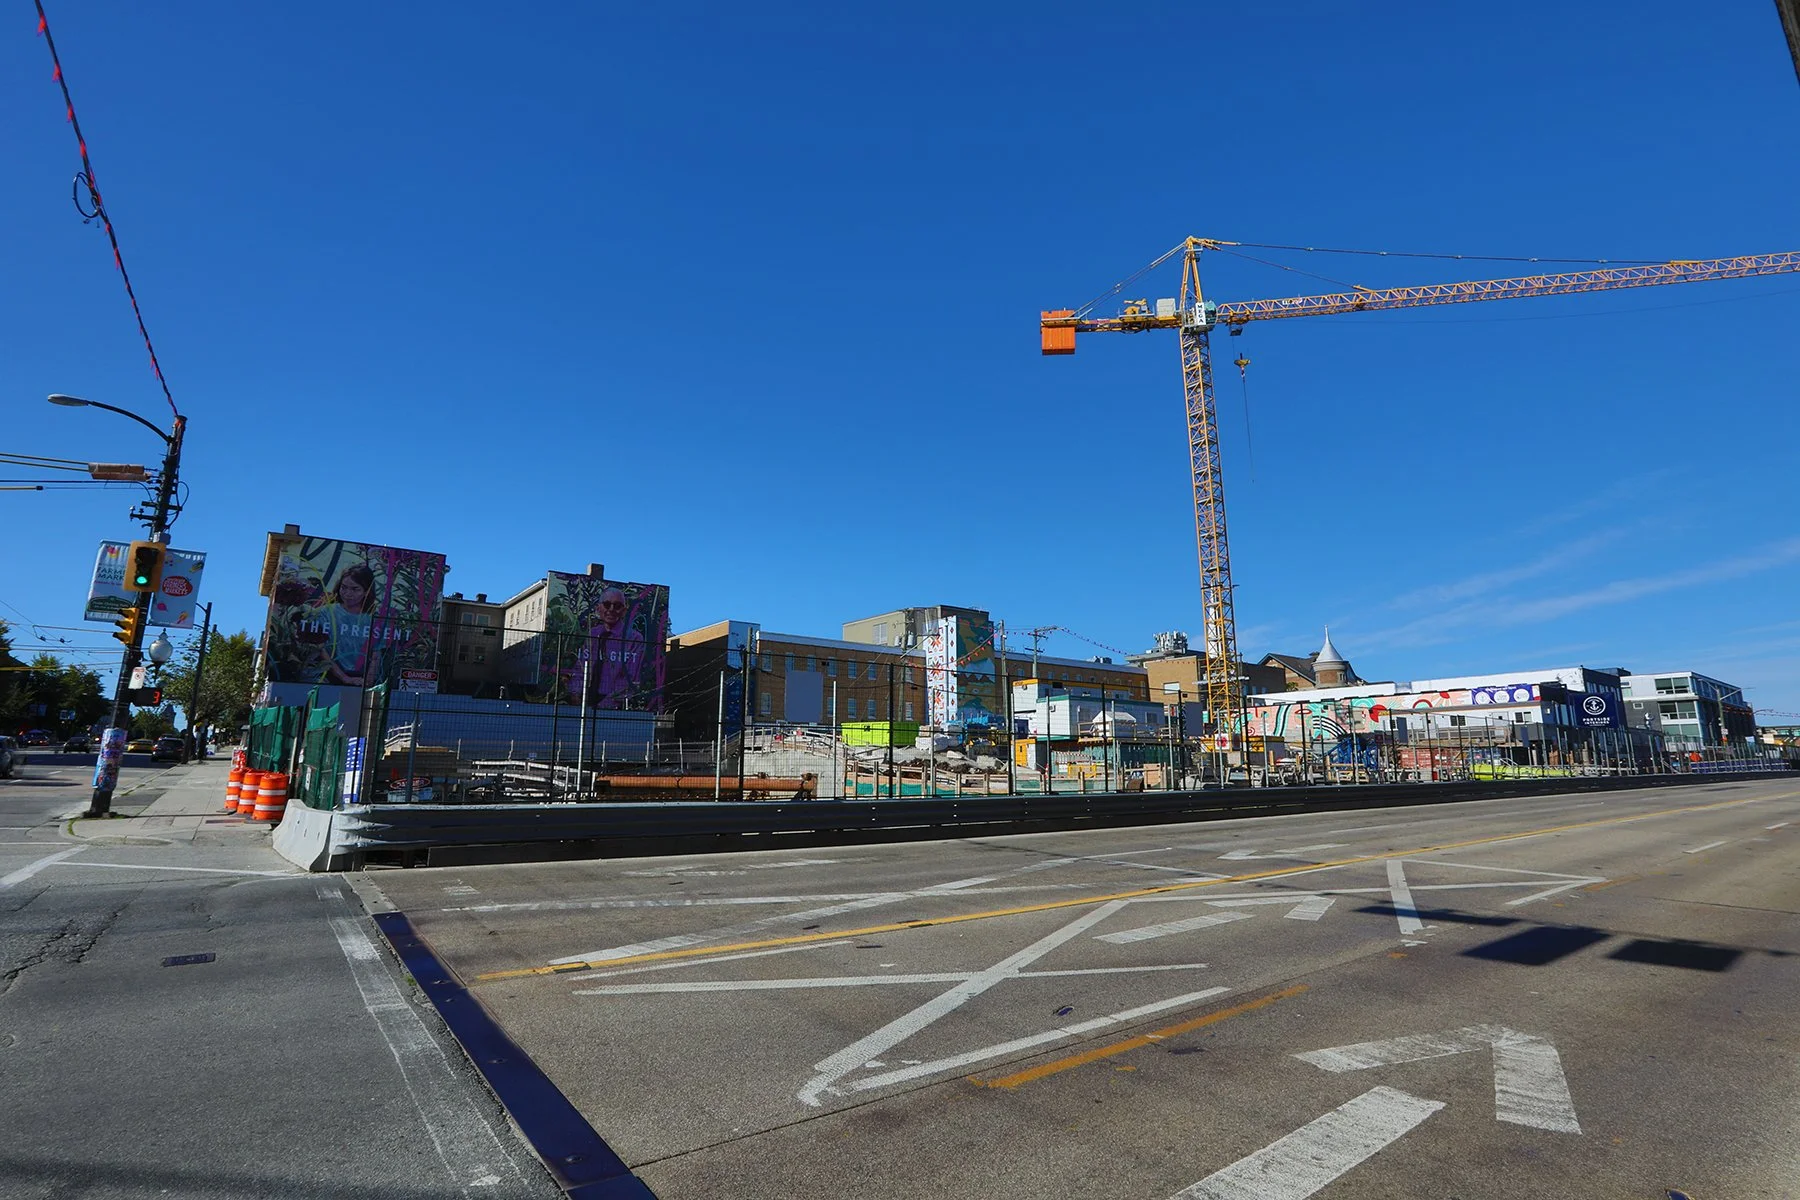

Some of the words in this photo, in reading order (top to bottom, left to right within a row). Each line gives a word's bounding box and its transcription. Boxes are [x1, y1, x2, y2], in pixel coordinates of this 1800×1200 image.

[300, 620, 331, 634] THE
[340, 624, 412, 641] PRESENT
[577, 648, 590, 659] IS
[610, 651, 637, 662] GIFT
[407, 671, 432, 679] DANGER
[153, 691, 160, 704] 3
